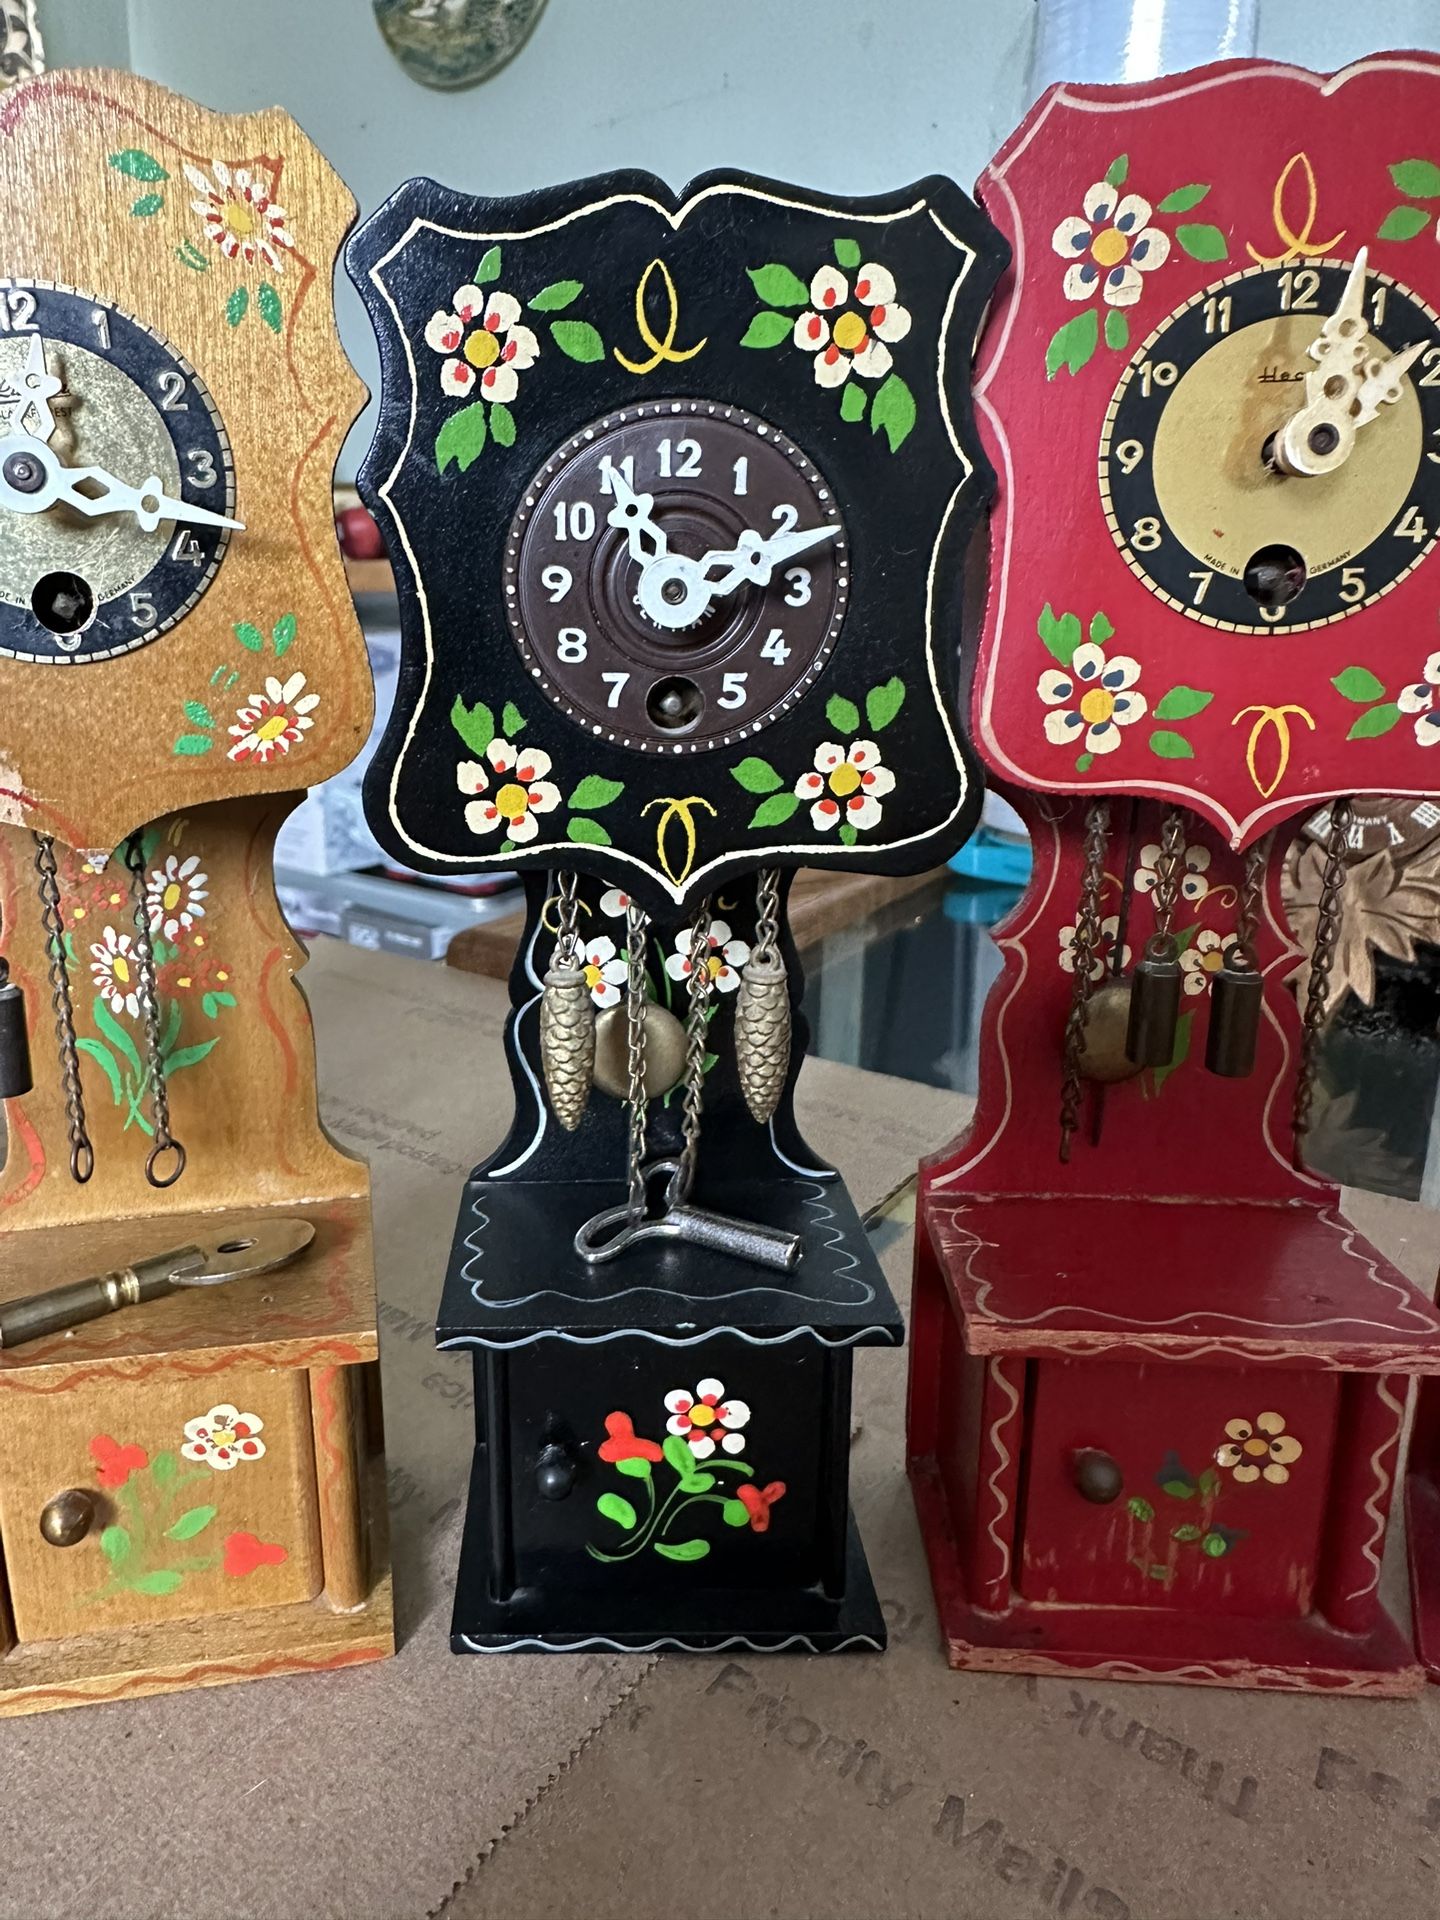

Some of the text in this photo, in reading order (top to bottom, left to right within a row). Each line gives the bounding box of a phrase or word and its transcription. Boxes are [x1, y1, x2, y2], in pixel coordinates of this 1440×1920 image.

[1277, 270, 1320, 311] 12
[1371, 287, 1387, 327] 1
[92, 310, 112, 349] 1
[1203, 296, 1232, 334] 11
[1138, 360, 1178, 398] 10
[1418, 347, 1440, 387] 2
[158, 371, 189, 412] 2
[186, 449, 218, 488] 3
[656, 438, 702, 478] 12
[732, 456, 748, 495] 1
[1115, 439, 1144, 475] 9
[553, 501, 596, 542] 10
[771, 504, 799, 541] 2
[1130, 516, 1162, 552] 8
[1393, 506, 1428, 543] 4
[171, 530, 205, 567] 4
[1203, 550, 1351, 576] MADE IN GERMANY
[15, 596, 26, 606] IN
[97, 575, 136, 602] GERMANY
[541, 564, 573, 603] 9
[784, 567, 812, 607] 3
[1188, 571, 1213, 606] 7
[1339, 568, 1366, 603] 5
[129, 592, 159, 630] 5
[556, 627, 588, 664] 8
[760, 628, 792, 666] 4
[601, 672, 631, 709] 7
[717, 672, 748, 710] 5
